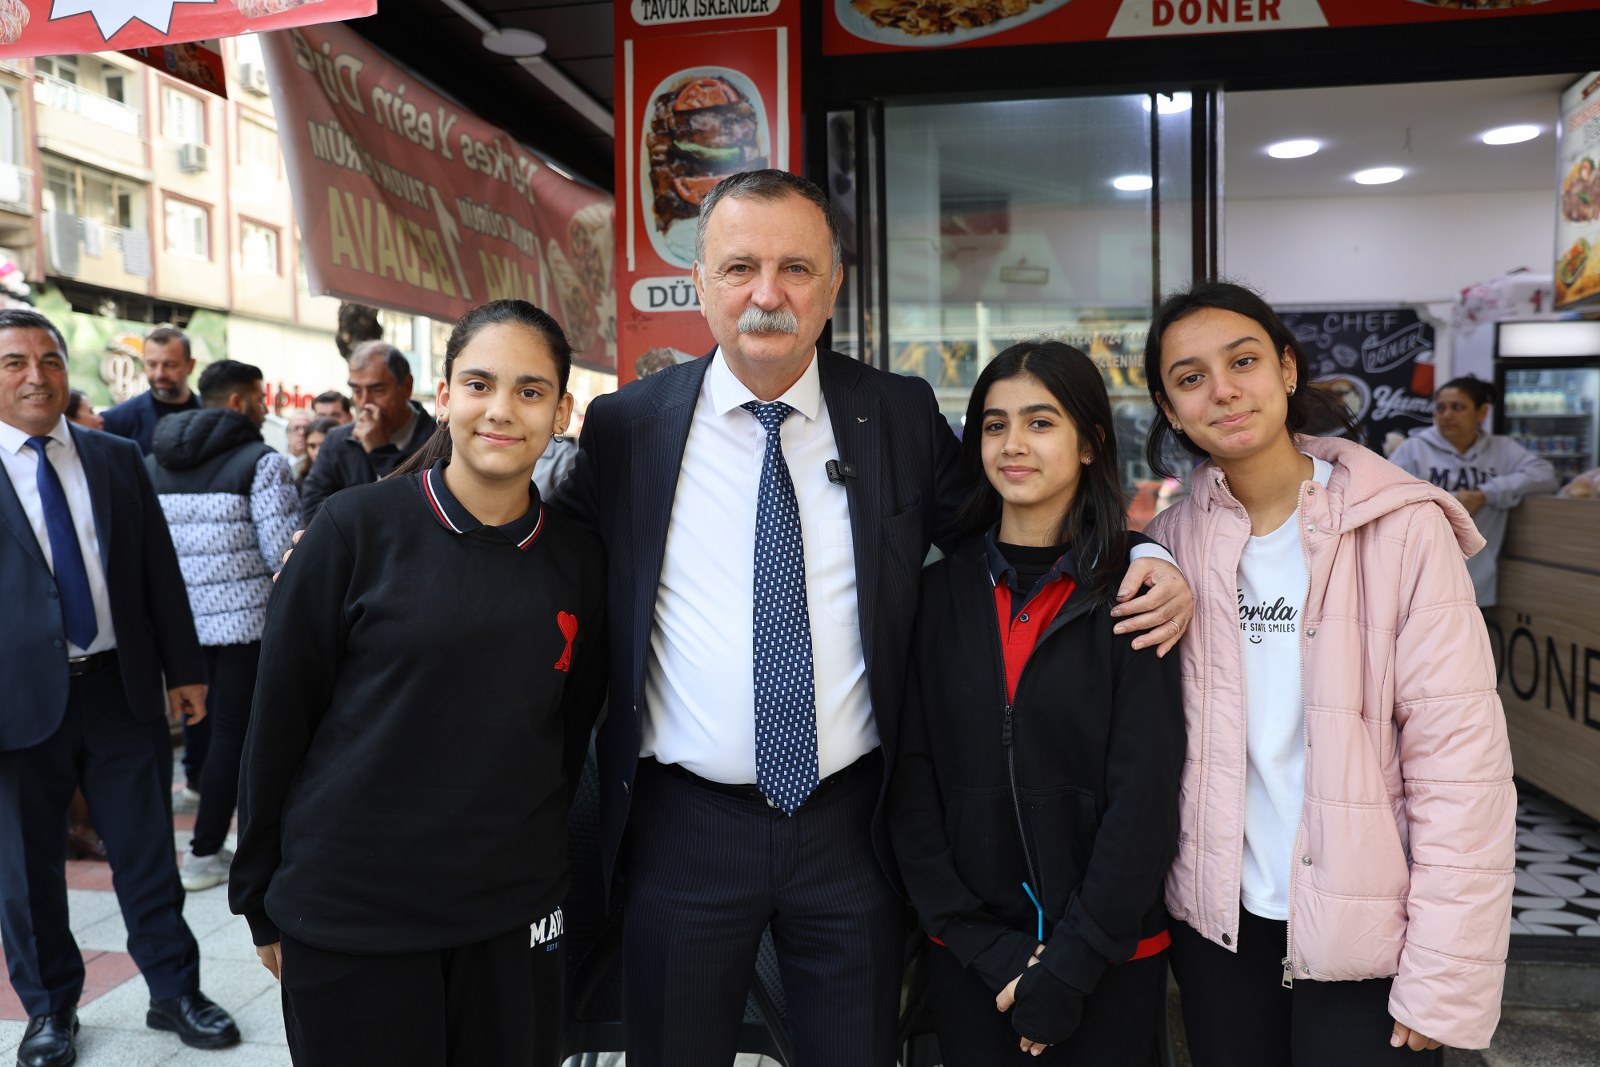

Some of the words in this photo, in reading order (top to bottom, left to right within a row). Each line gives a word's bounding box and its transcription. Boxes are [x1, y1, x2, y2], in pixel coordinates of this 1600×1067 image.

[641, 0, 690, 21] TAVUK
[1323, 312, 1399, 334] CHEF
[1268, 623, 1296, 633] SMILES
